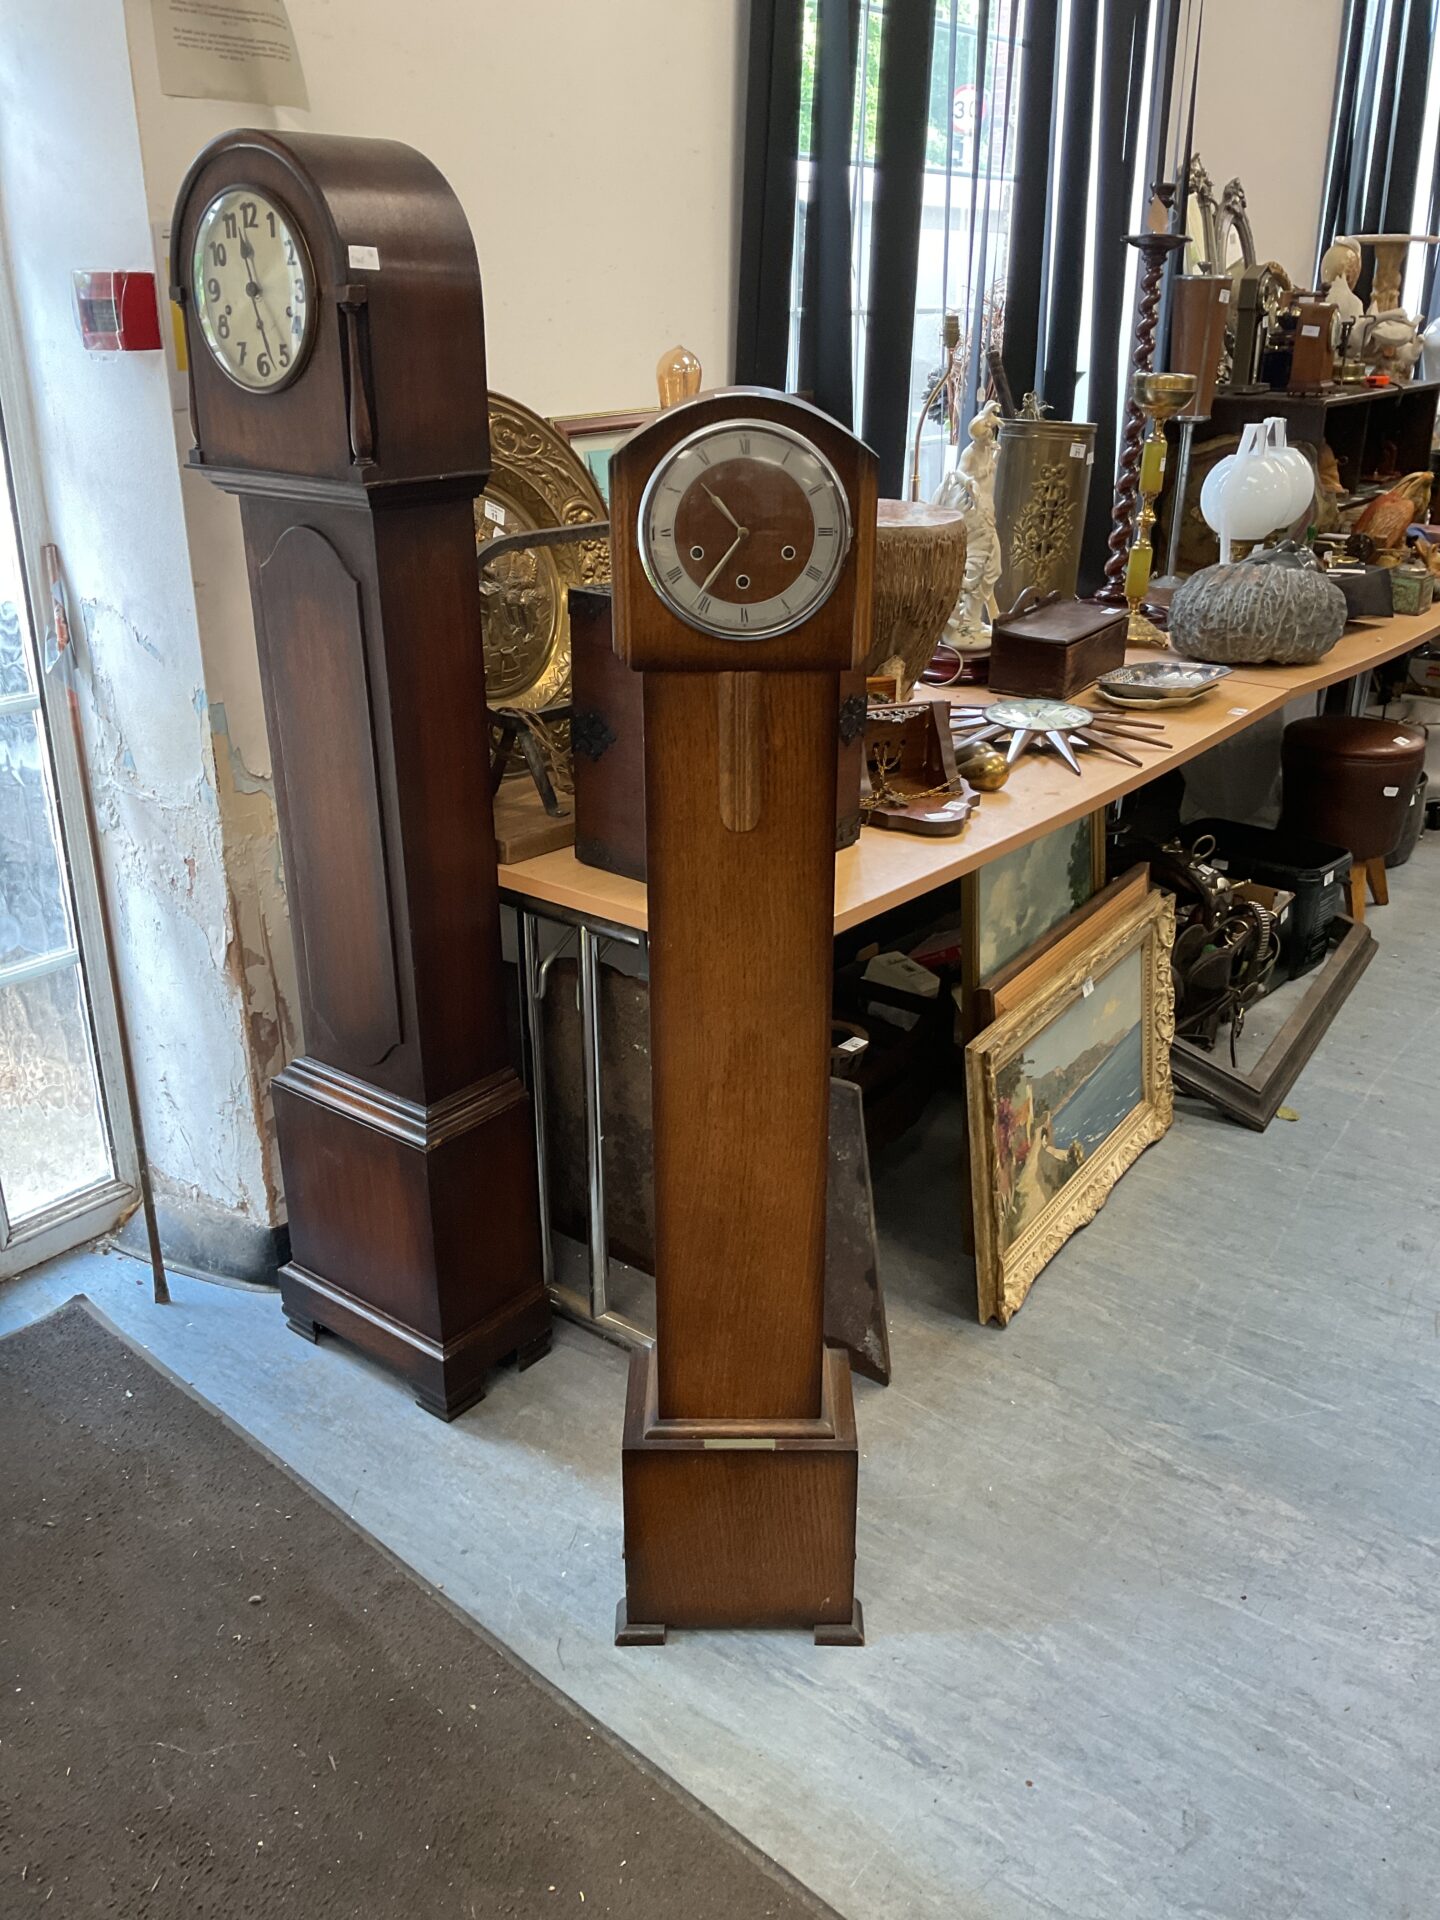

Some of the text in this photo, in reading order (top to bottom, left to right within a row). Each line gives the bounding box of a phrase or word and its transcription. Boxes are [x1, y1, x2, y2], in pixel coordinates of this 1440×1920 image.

[222, 212, 237, 238] 11
[240, 202, 259, 228] 12
[266, 212, 276, 237] 1
[208, 242, 227, 267] 10
[284, 240, 297, 265] 2
[208, 278, 221, 302] 9
[294, 278, 306, 303] 3
[217, 314, 230, 339] 8
[236, 342, 247, 366] 7
[256, 353, 271, 377] 6
[279, 344, 290, 367] 5
[818, 527, 834, 537] III
